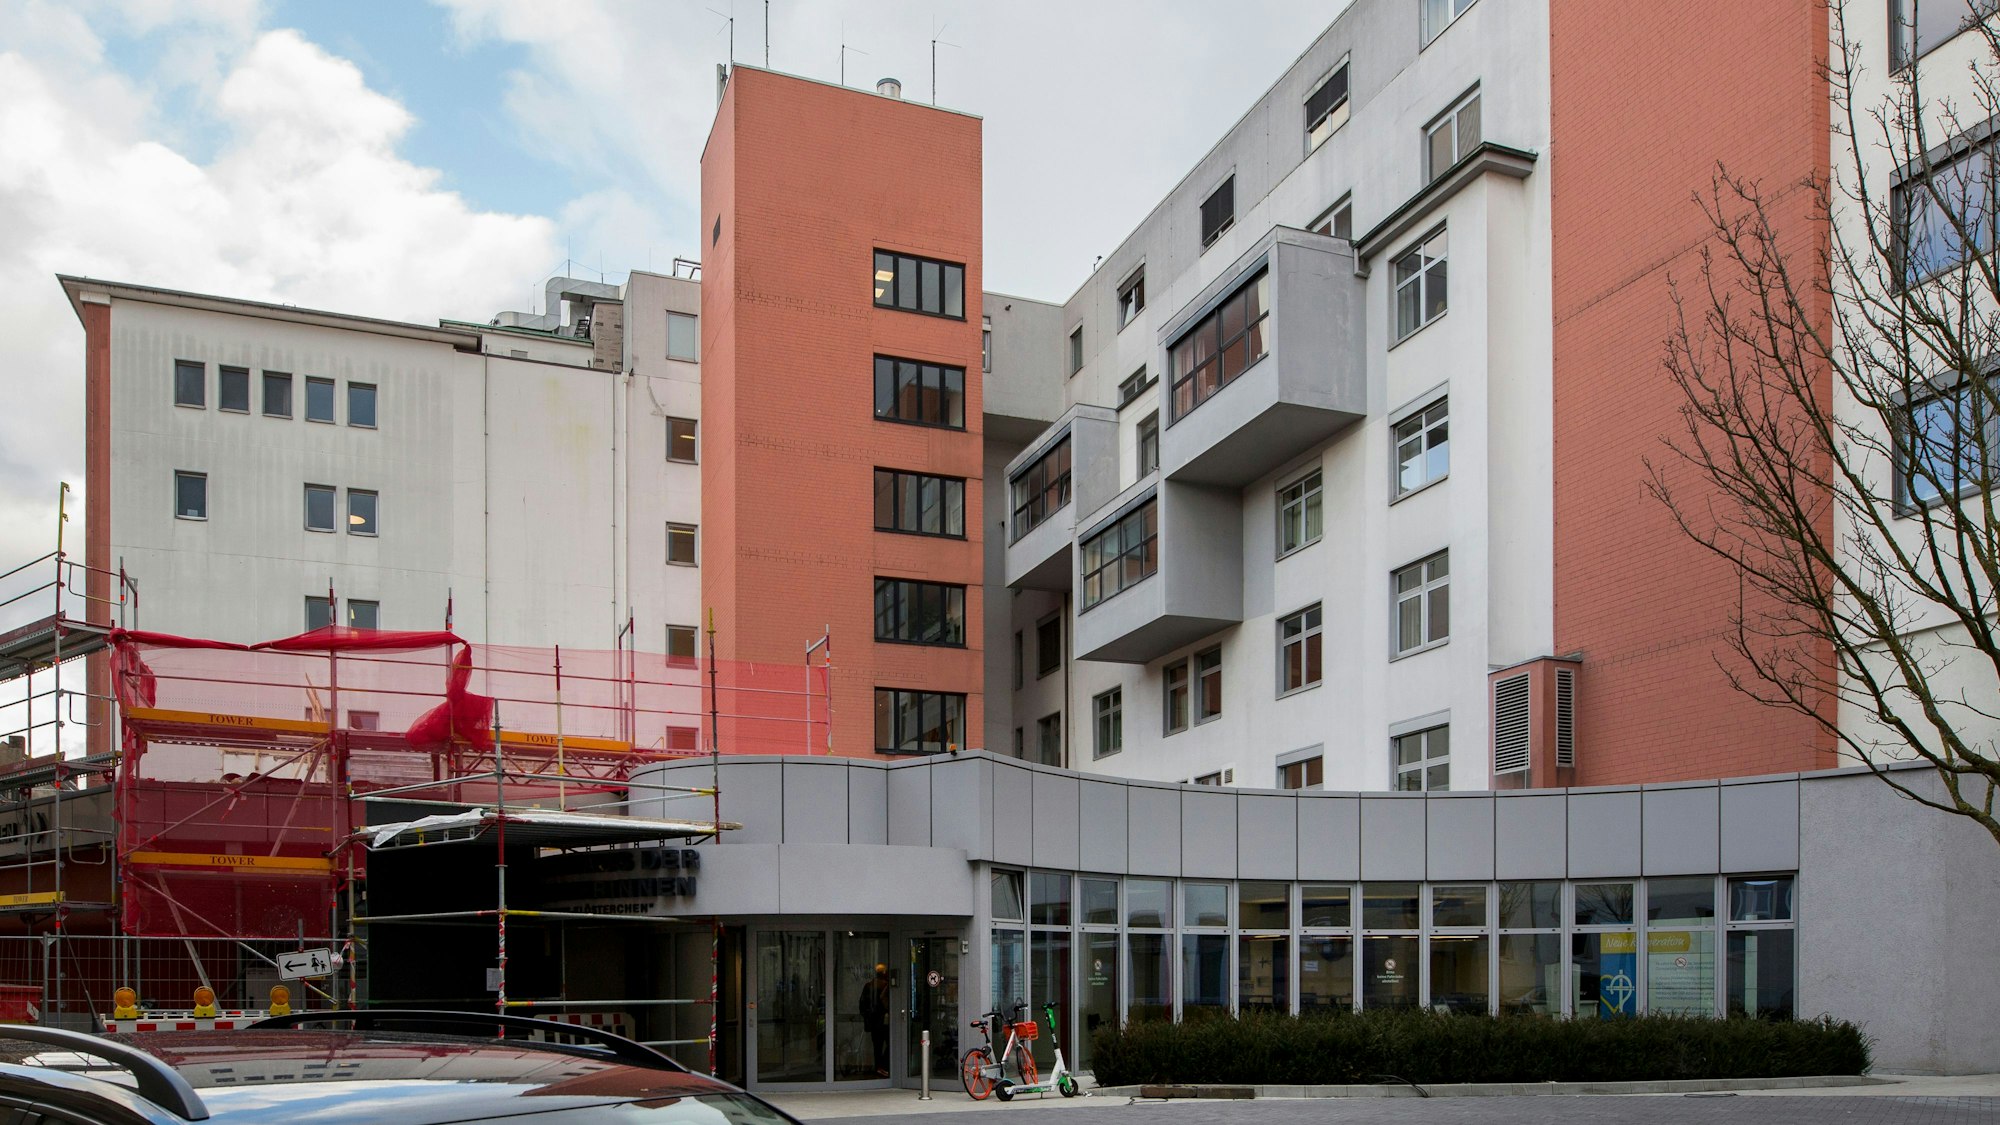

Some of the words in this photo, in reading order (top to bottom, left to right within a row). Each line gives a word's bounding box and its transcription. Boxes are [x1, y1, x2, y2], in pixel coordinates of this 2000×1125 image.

[208, 713, 254, 726] TOWER
[525, 733, 559, 744] TOWE
[210, 855, 256, 866] TOWER
[640, 848, 700, 870] DER
[1606, 937, 1629, 949] Neue
